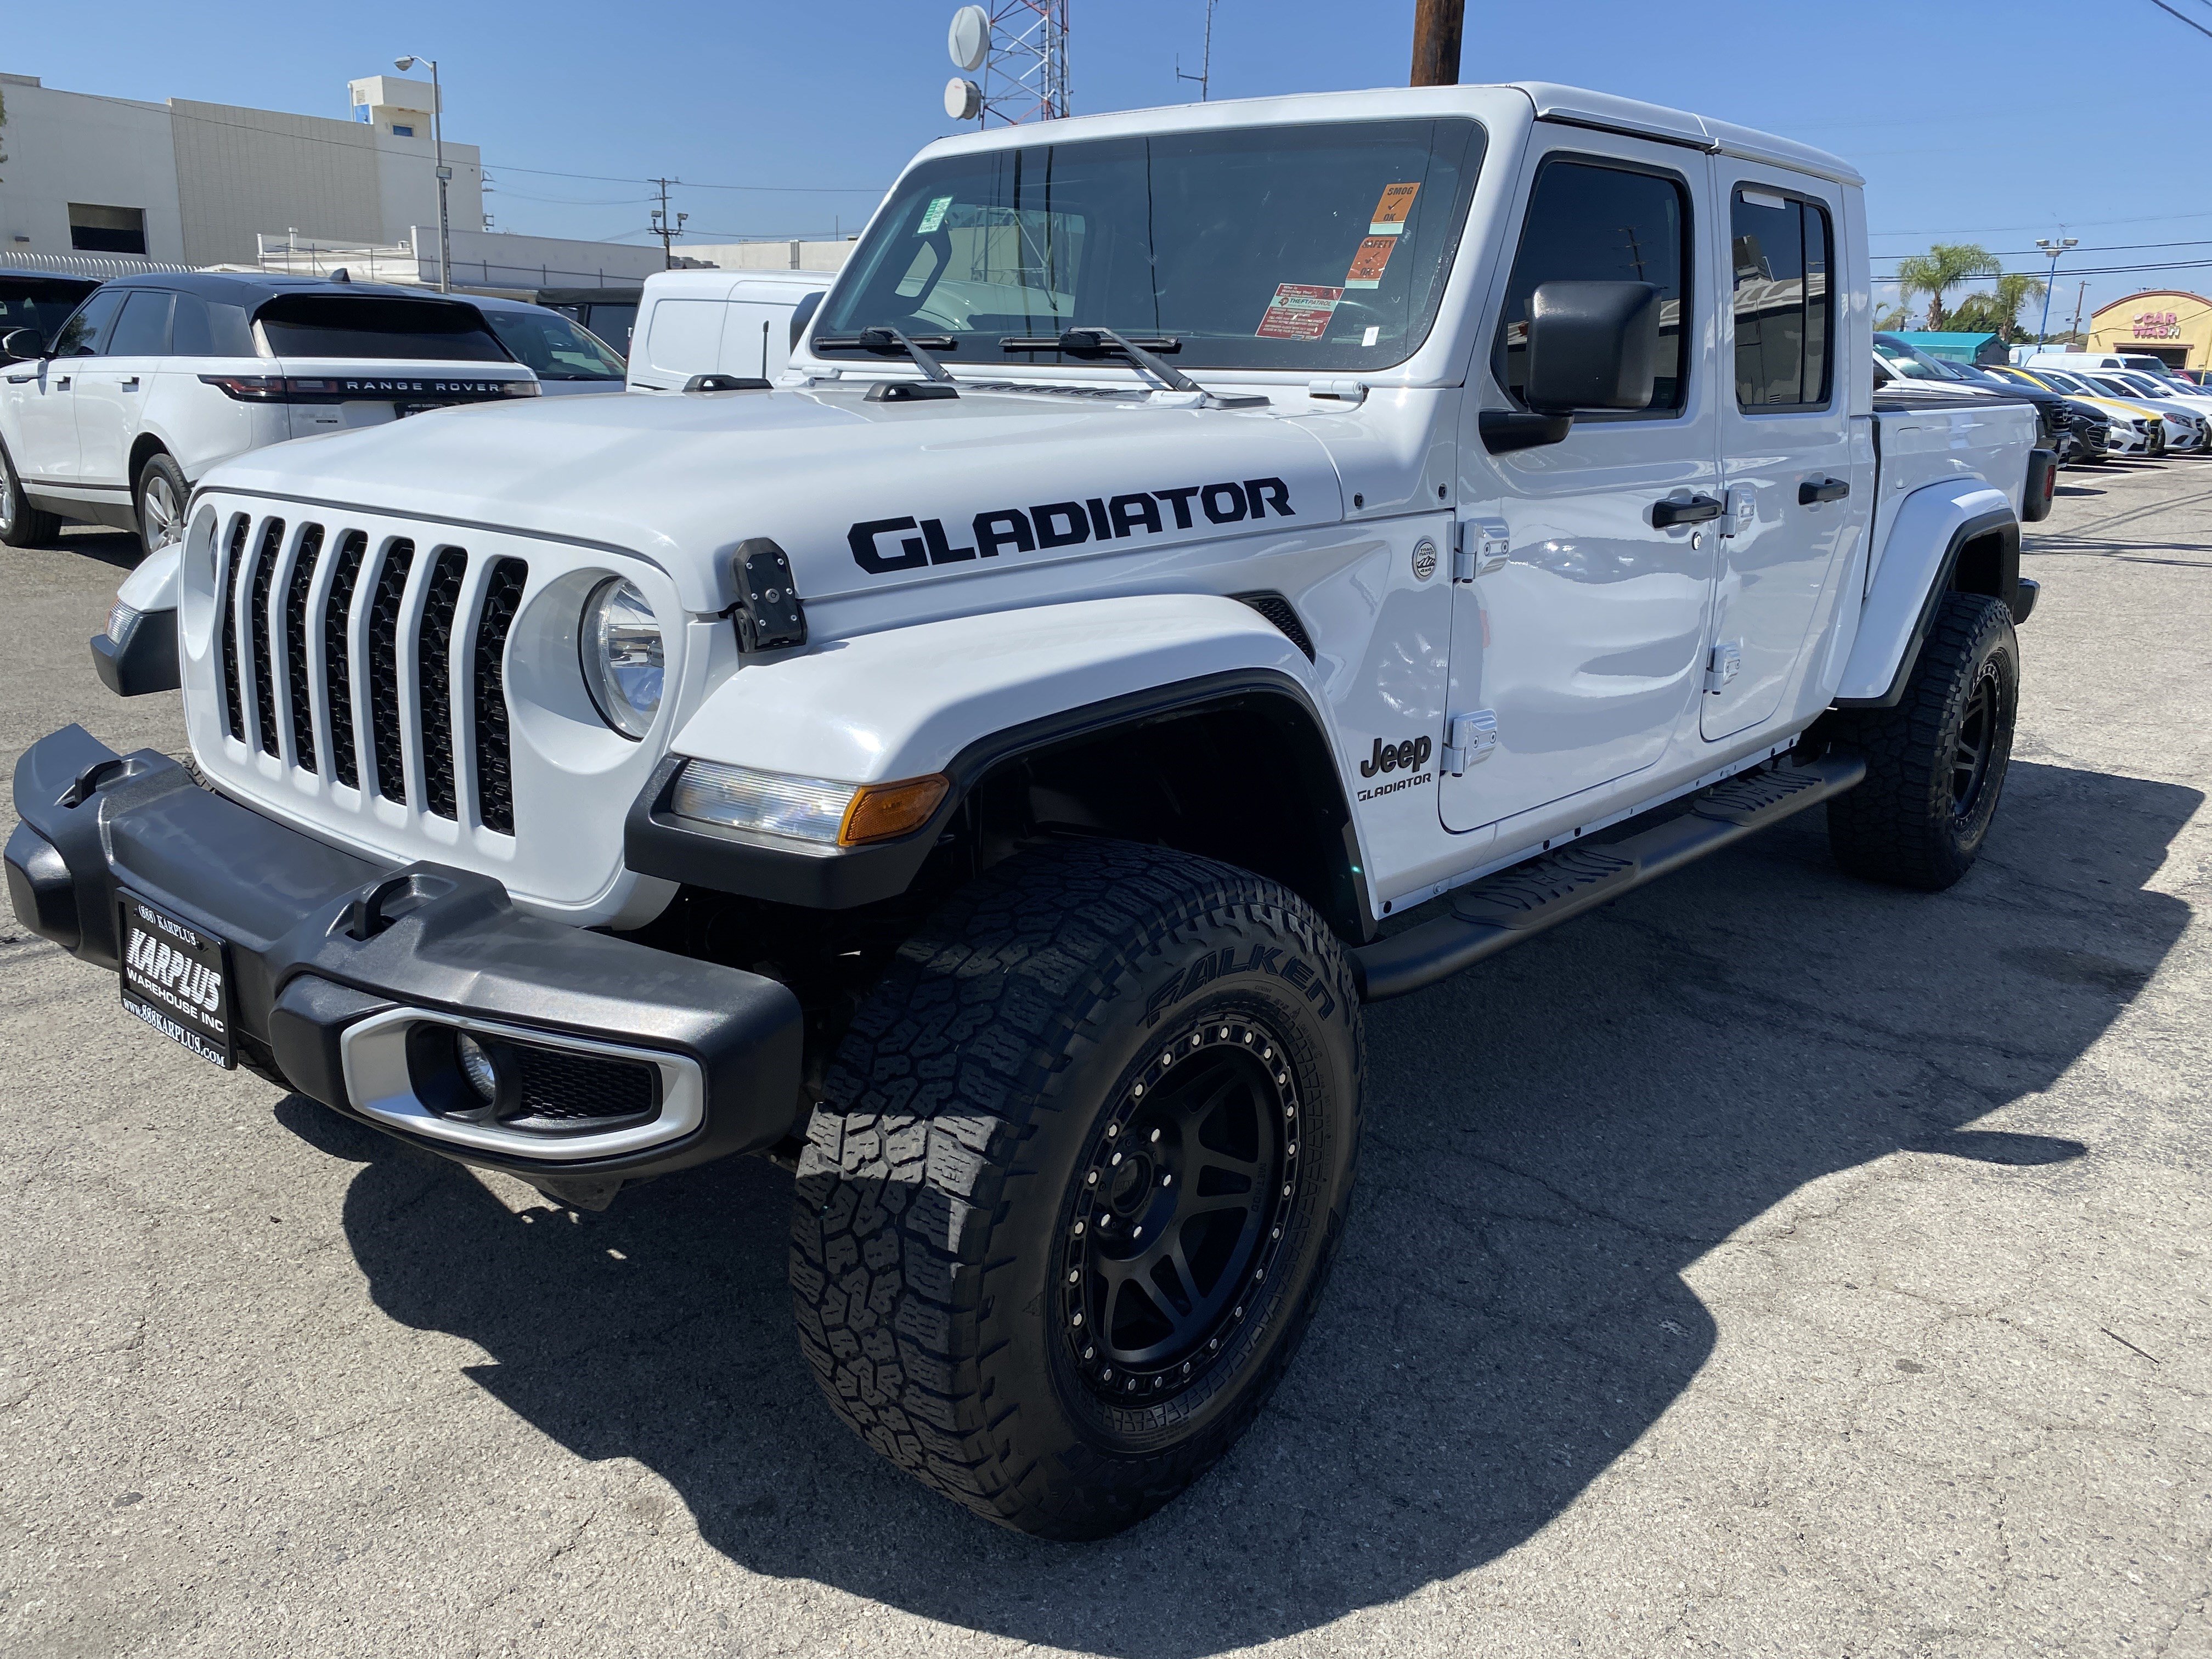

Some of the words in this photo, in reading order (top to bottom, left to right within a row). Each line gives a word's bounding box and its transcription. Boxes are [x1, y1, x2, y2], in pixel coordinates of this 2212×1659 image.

[1387, 187, 1414, 196] SMOG
[1362, 240, 1395, 249] SAFETY
[1360, 267, 1372, 276] OK
[2143, 312, 2177, 324] CAR
[2133, 325, 2180, 338] WASH
[347, 381, 422, 391] RANGE
[436, 383, 499, 391] ROVER
[847, 477, 1296, 574] GLADIATOR
[1361, 736, 1431, 777] Jeep
[1357, 773, 1431, 802] GLADIATOR
[138, 904, 156, 924] (888)
[156, 915, 196, 946] KARPLUS
[127, 927, 221, 1012] KARPLUS
[127, 967, 198, 1019] WAREHOUSE
[201, 1011, 224, 1032] INC
